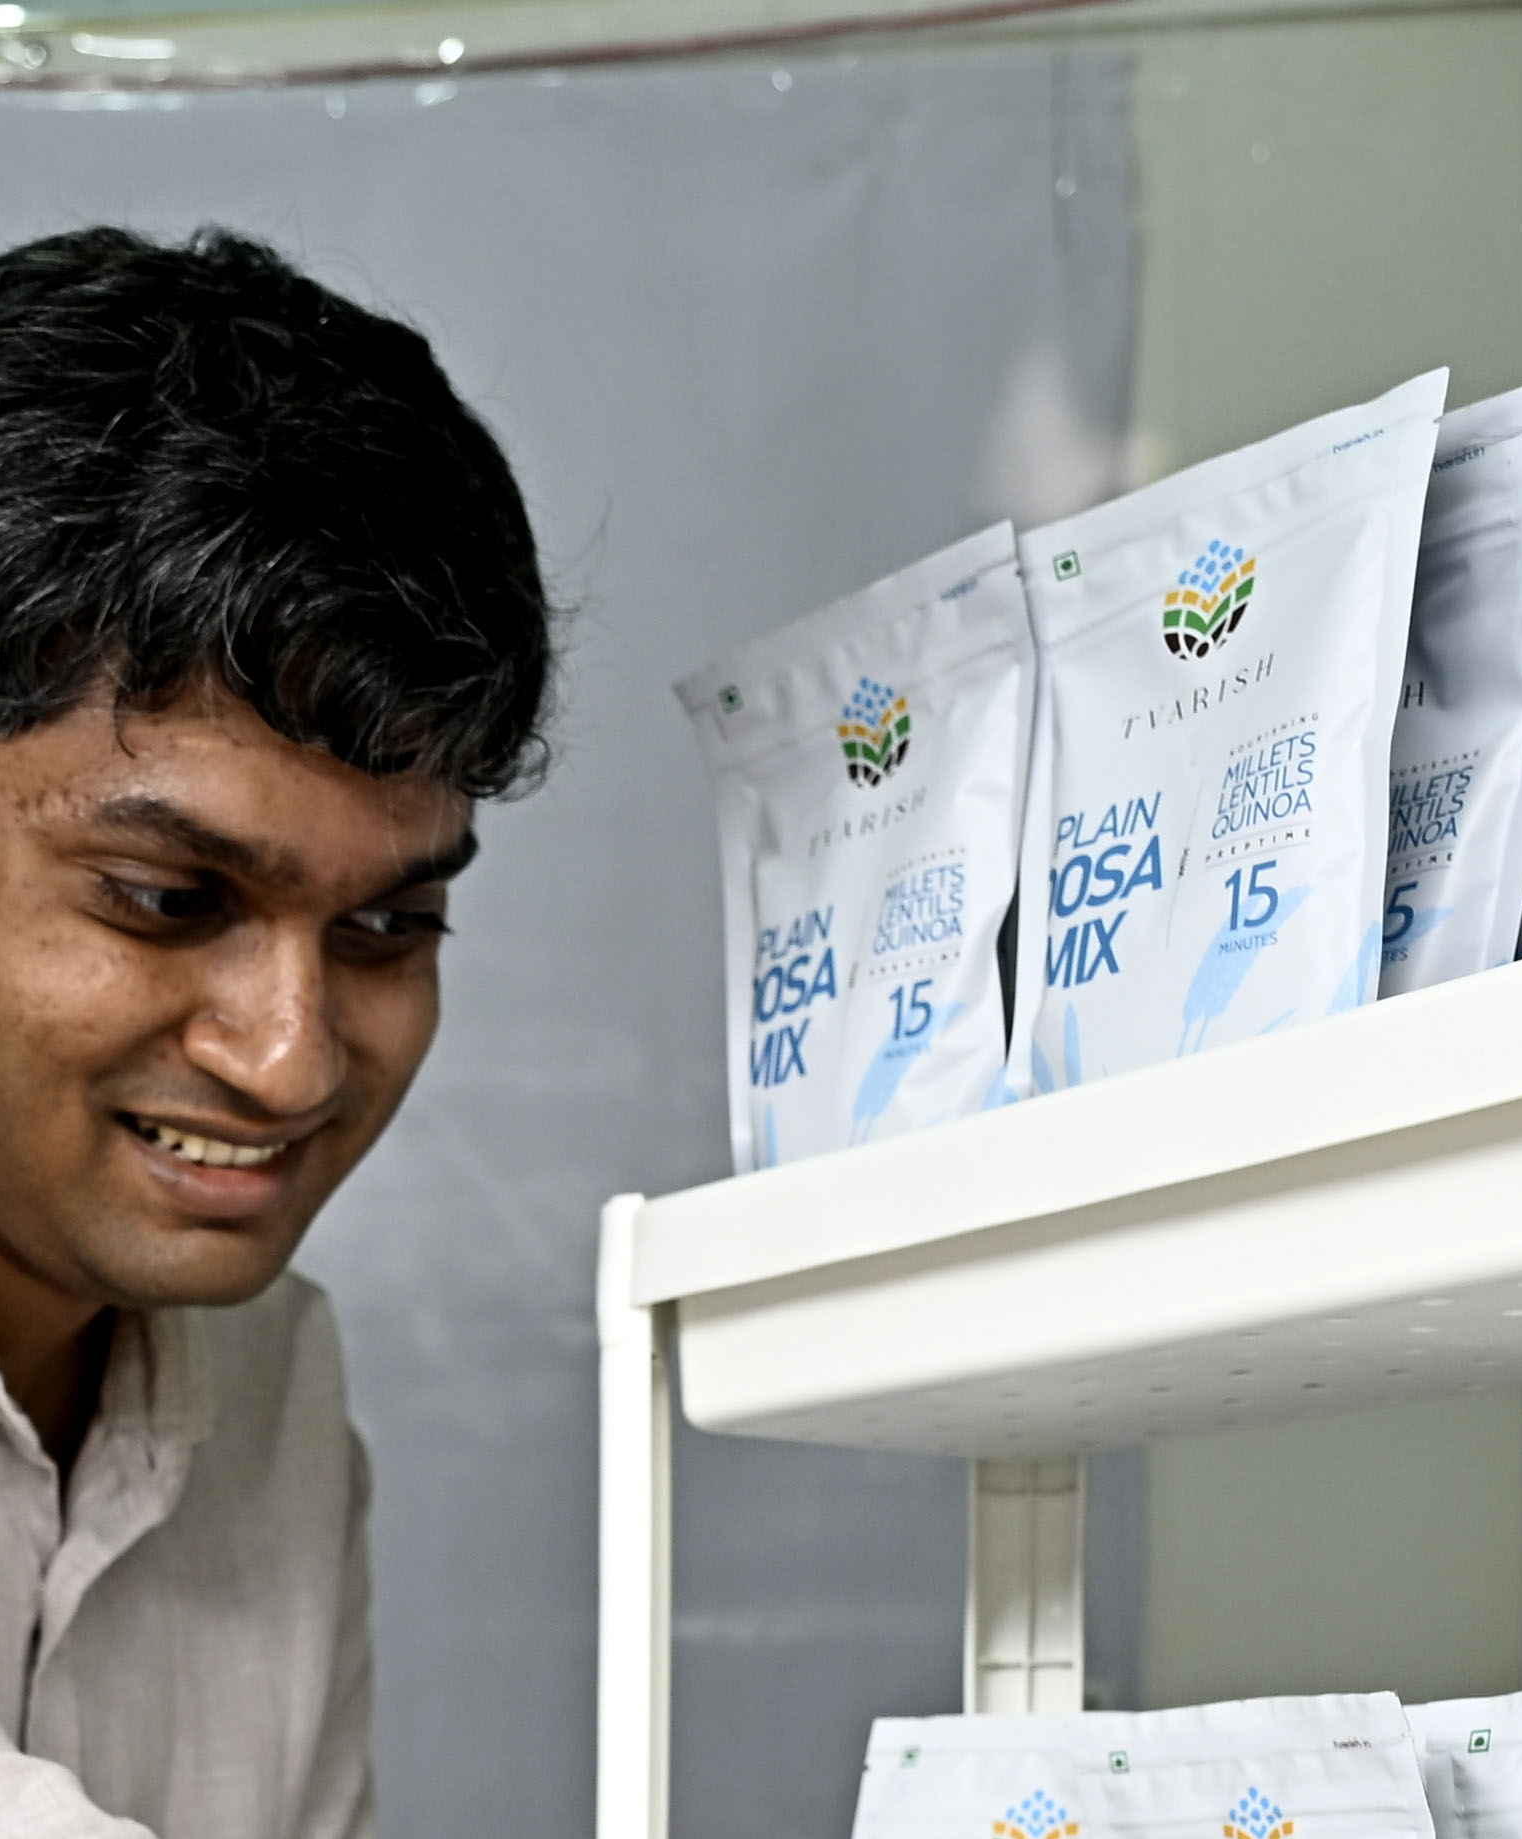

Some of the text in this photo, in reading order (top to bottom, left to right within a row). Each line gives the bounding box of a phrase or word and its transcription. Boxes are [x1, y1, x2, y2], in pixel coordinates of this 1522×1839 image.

[1123, 653, 1274, 739] TVARISH
[1217, 759, 1314, 815] LENTILS
[1223, 731, 1316, 788] MILLETS
[1391, 765, 1474, 806] ILLETS
[1054, 790, 1161, 858] PLAIN
[1211, 789, 1312, 840] QUINOA
[1225, 860, 1278, 931] 15
[889, 979, 933, 1041] 15
